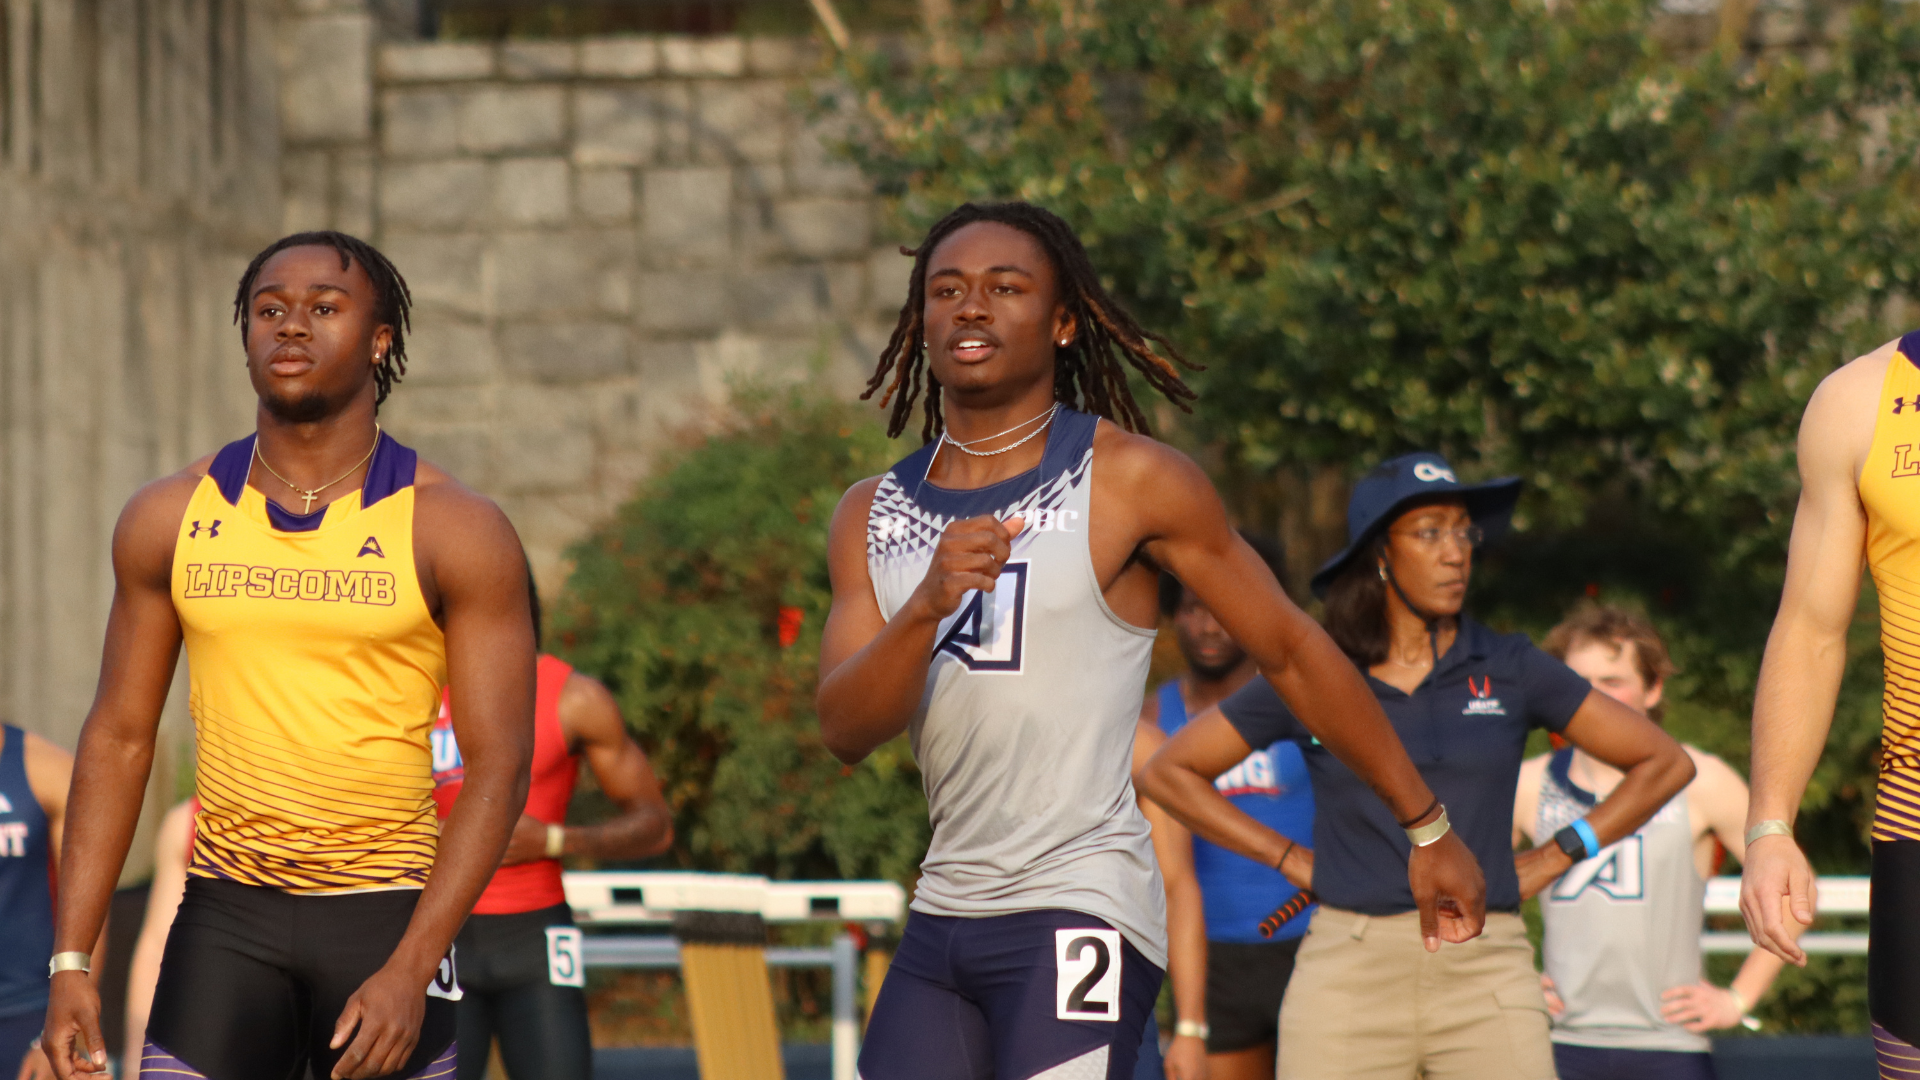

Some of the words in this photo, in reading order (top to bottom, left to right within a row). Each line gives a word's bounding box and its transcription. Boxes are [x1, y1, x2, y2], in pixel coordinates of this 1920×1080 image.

[1891, 443, 1920, 478] L
[184, 563, 396, 607] LIPSCOMB
[555, 935, 576, 979] 5
[1065, 935, 1111, 1015] 2
